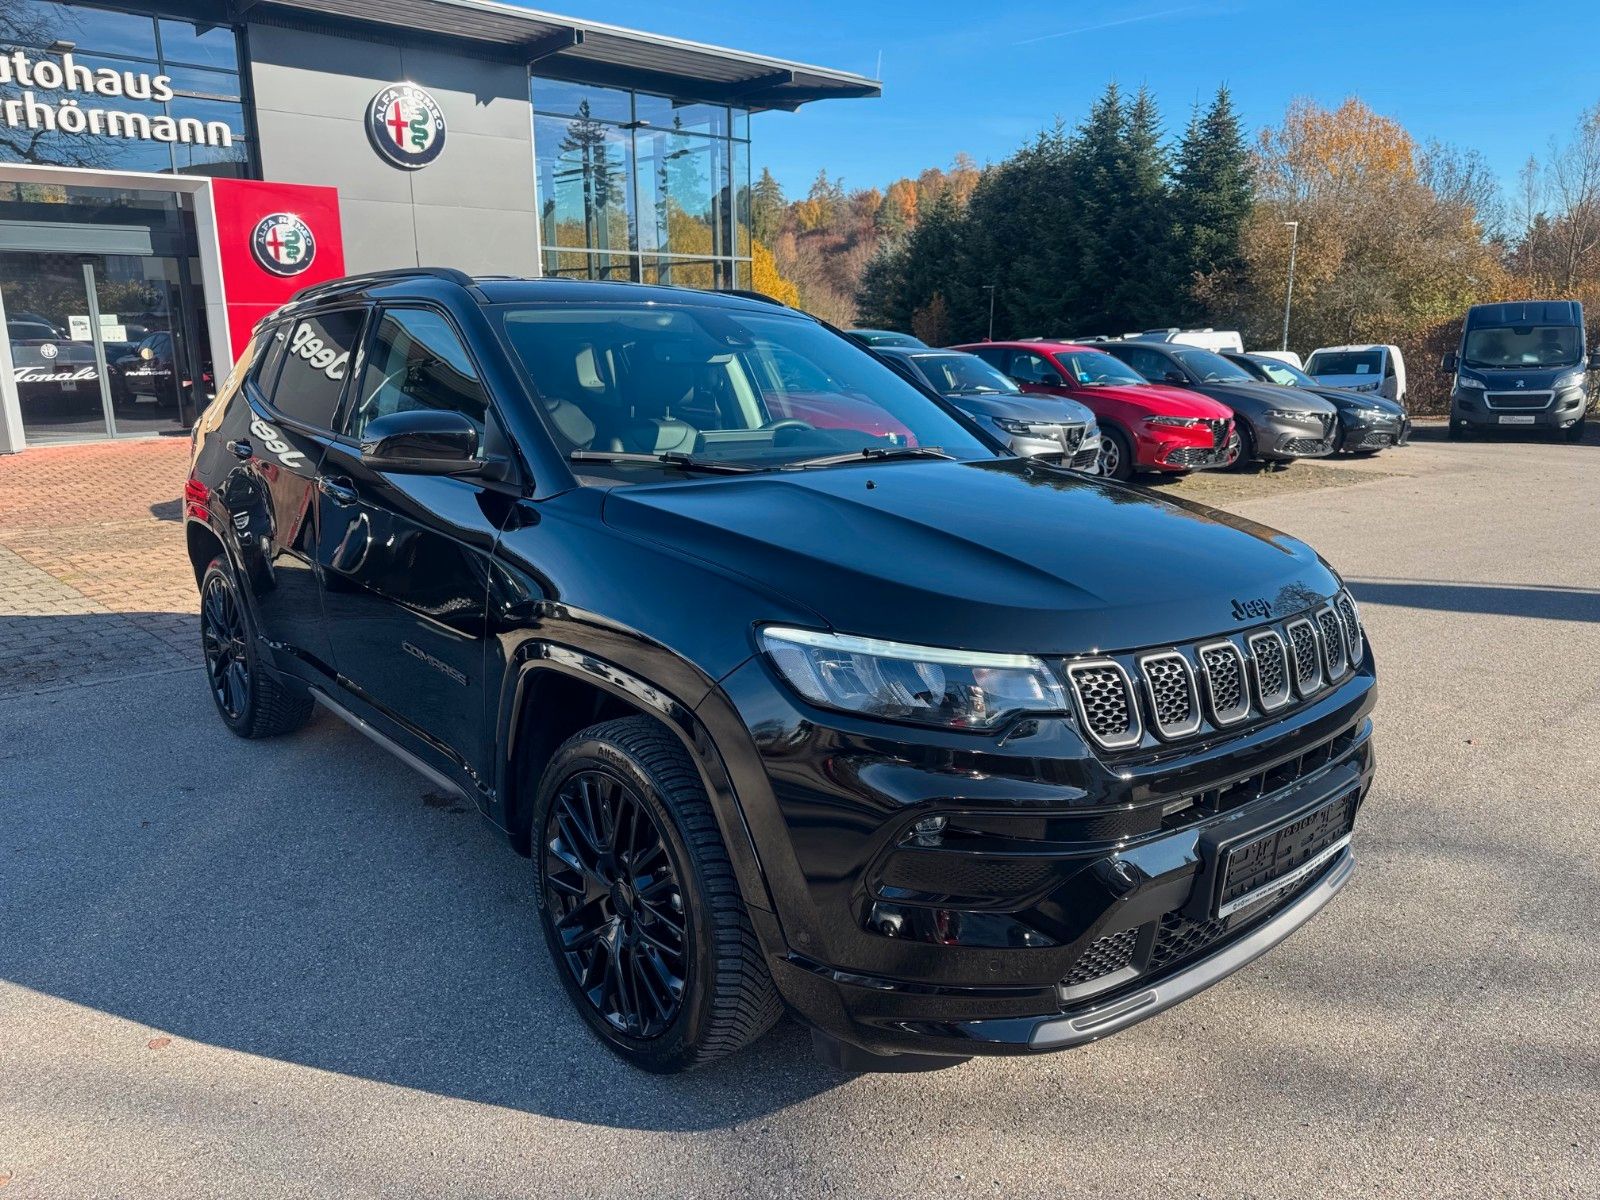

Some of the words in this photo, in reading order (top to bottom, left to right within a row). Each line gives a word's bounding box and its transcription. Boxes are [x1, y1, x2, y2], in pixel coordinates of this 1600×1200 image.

[0, 91, 232, 147] rhörmann
[376, 90, 399, 122] ALFA
[403, 87, 443, 130] ROMEO
[258, 220, 276, 244] ALFA
[279, 217, 312, 246] RMEO
[13, 367, 99, 382] Tonale
[1231, 598, 1272, 621] Jeep
